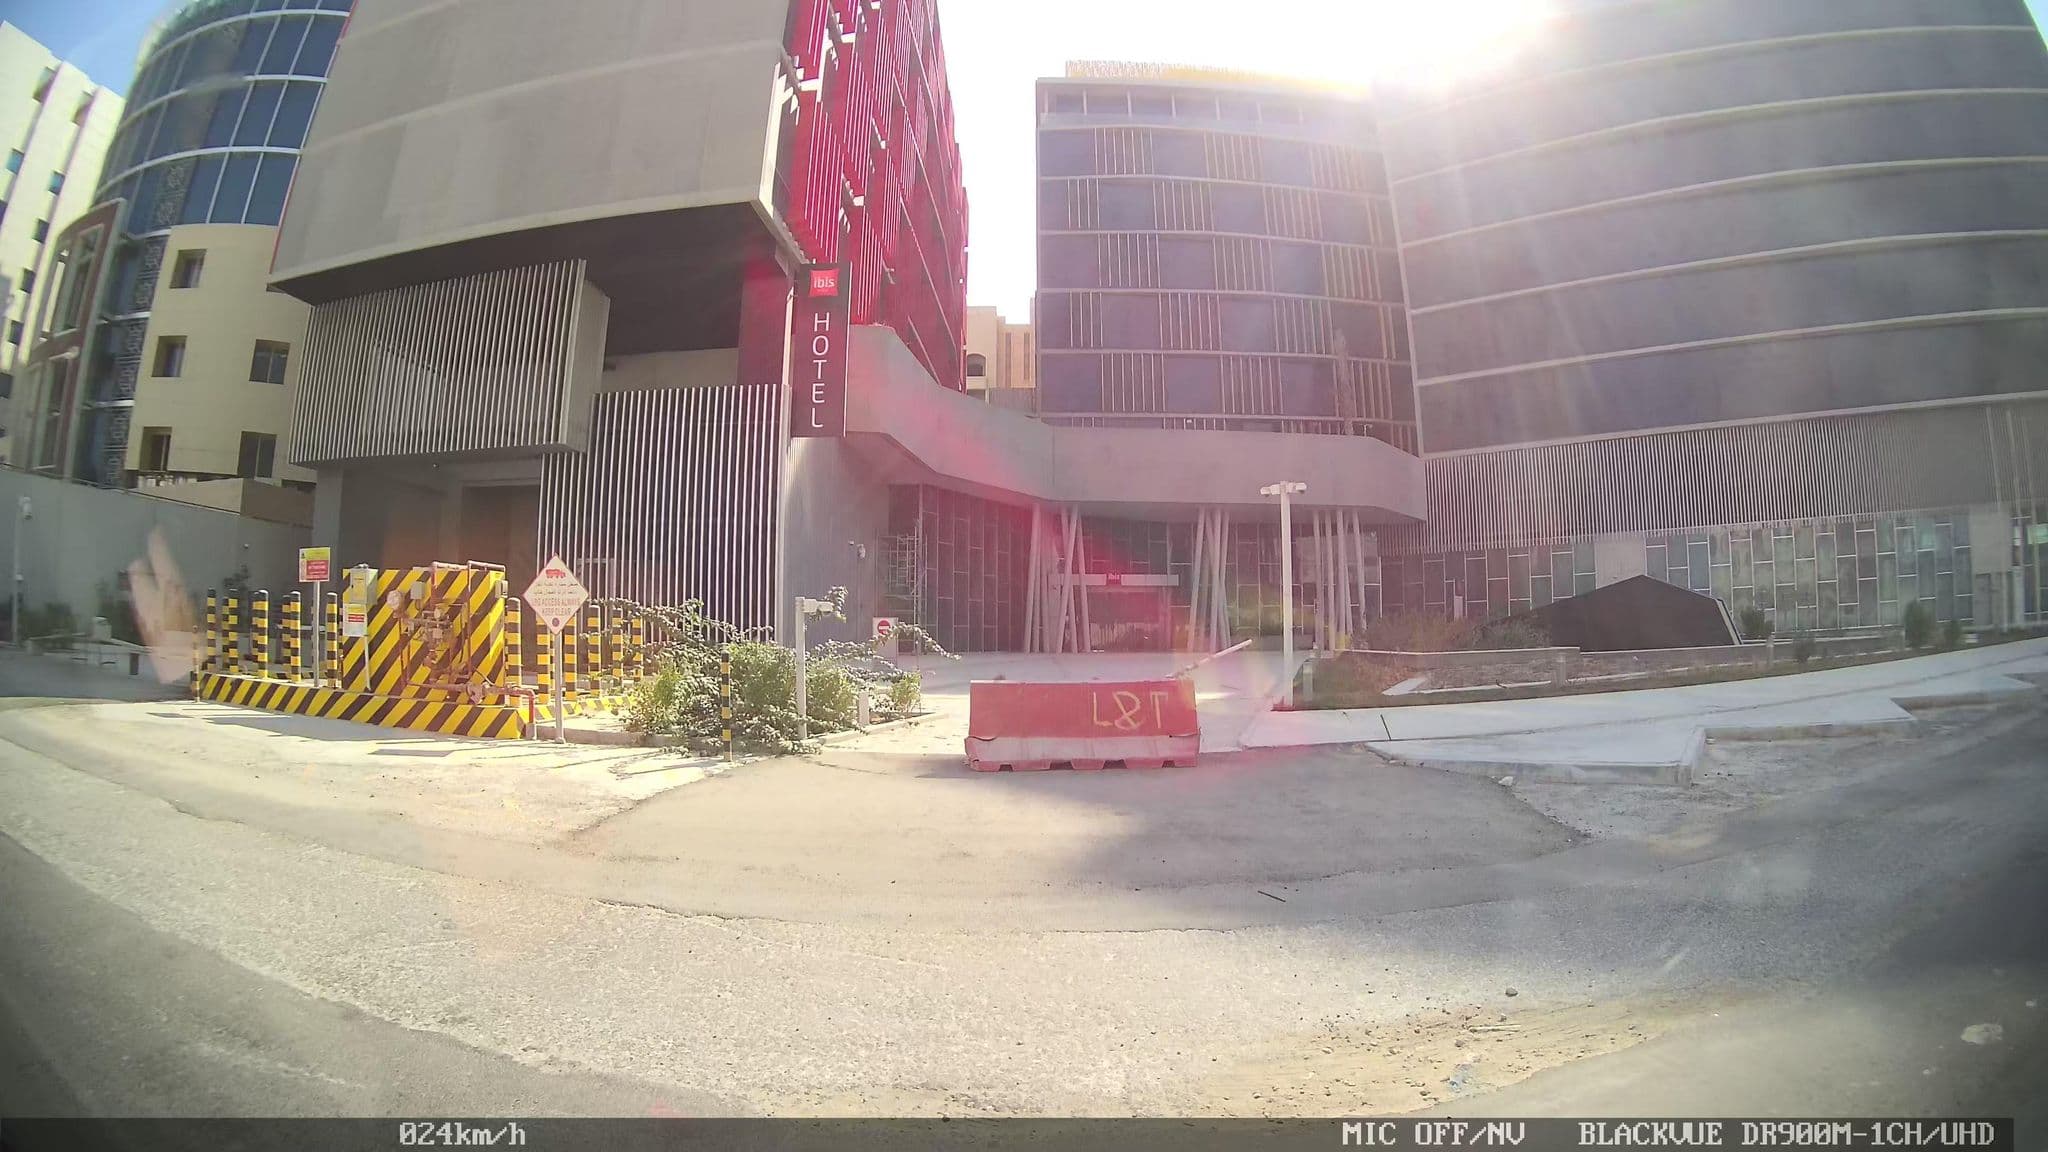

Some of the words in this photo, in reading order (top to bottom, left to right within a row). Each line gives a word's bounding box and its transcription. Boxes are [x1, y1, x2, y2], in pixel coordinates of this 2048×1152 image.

[813, 276, 835, 288] ibis
[811, 312, 830, 428] HOTEL
[555, 607, 571, 616] CLEAR
[1093, 691, 1169, 730] L&T
